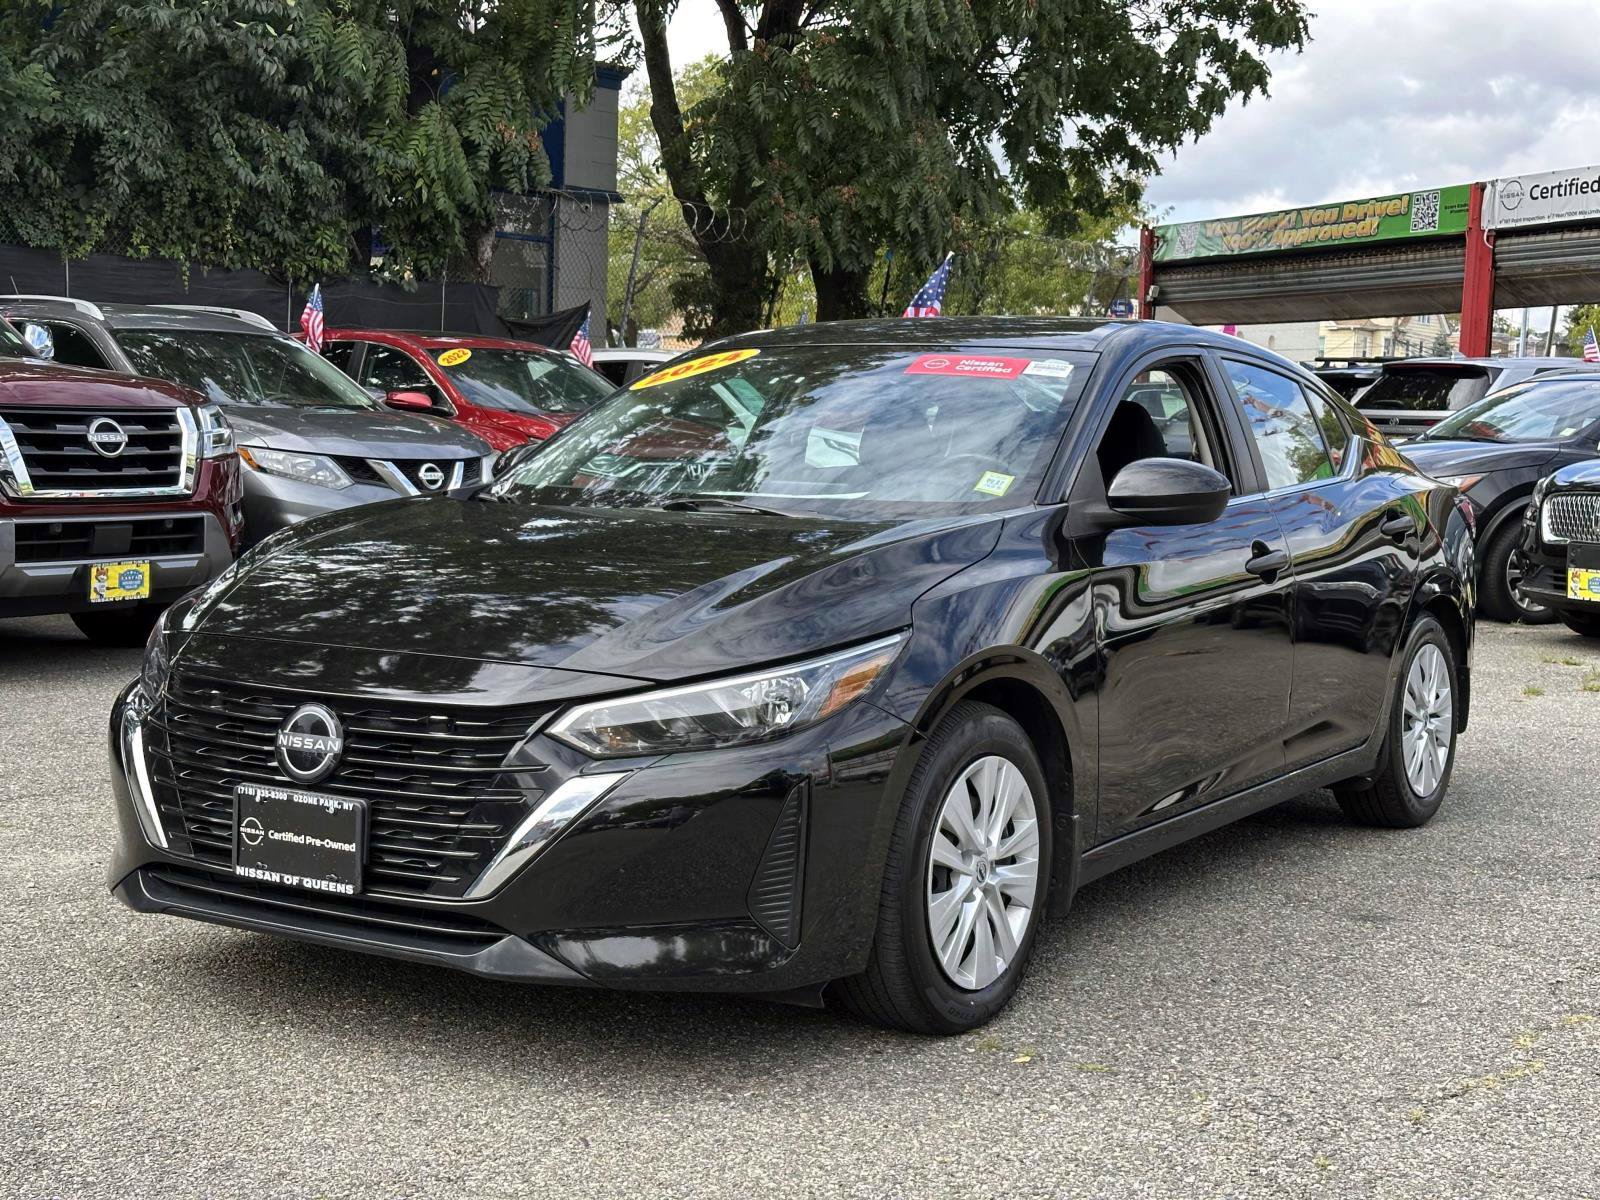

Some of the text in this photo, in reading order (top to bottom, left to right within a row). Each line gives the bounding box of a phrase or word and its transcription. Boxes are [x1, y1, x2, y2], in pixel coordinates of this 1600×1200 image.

[1529, 175, 1600, 200] Certified
[1301, 207, 1339, 226] You
[1342, 195, 1409, 222] Drive!
[1268, 217, 1379, 248] Approved!
[442, 349, 469, 364] 2022
[959, 359, 1004, 368] Nissan
[644, 351, 744, 385] 2024
[955, 365, 1012, 374] Certified
[278, 734, 339, 751] NISSAN
[293, 794, 318, 805] OZONE
[343, 801, 354, 811] NY
[240, 826, 265, 835] NISSAN
[268, 829, 356, 852] Certified Pre-Owned
[235, 865, 354, 895] NISSAN OF QUEENS
